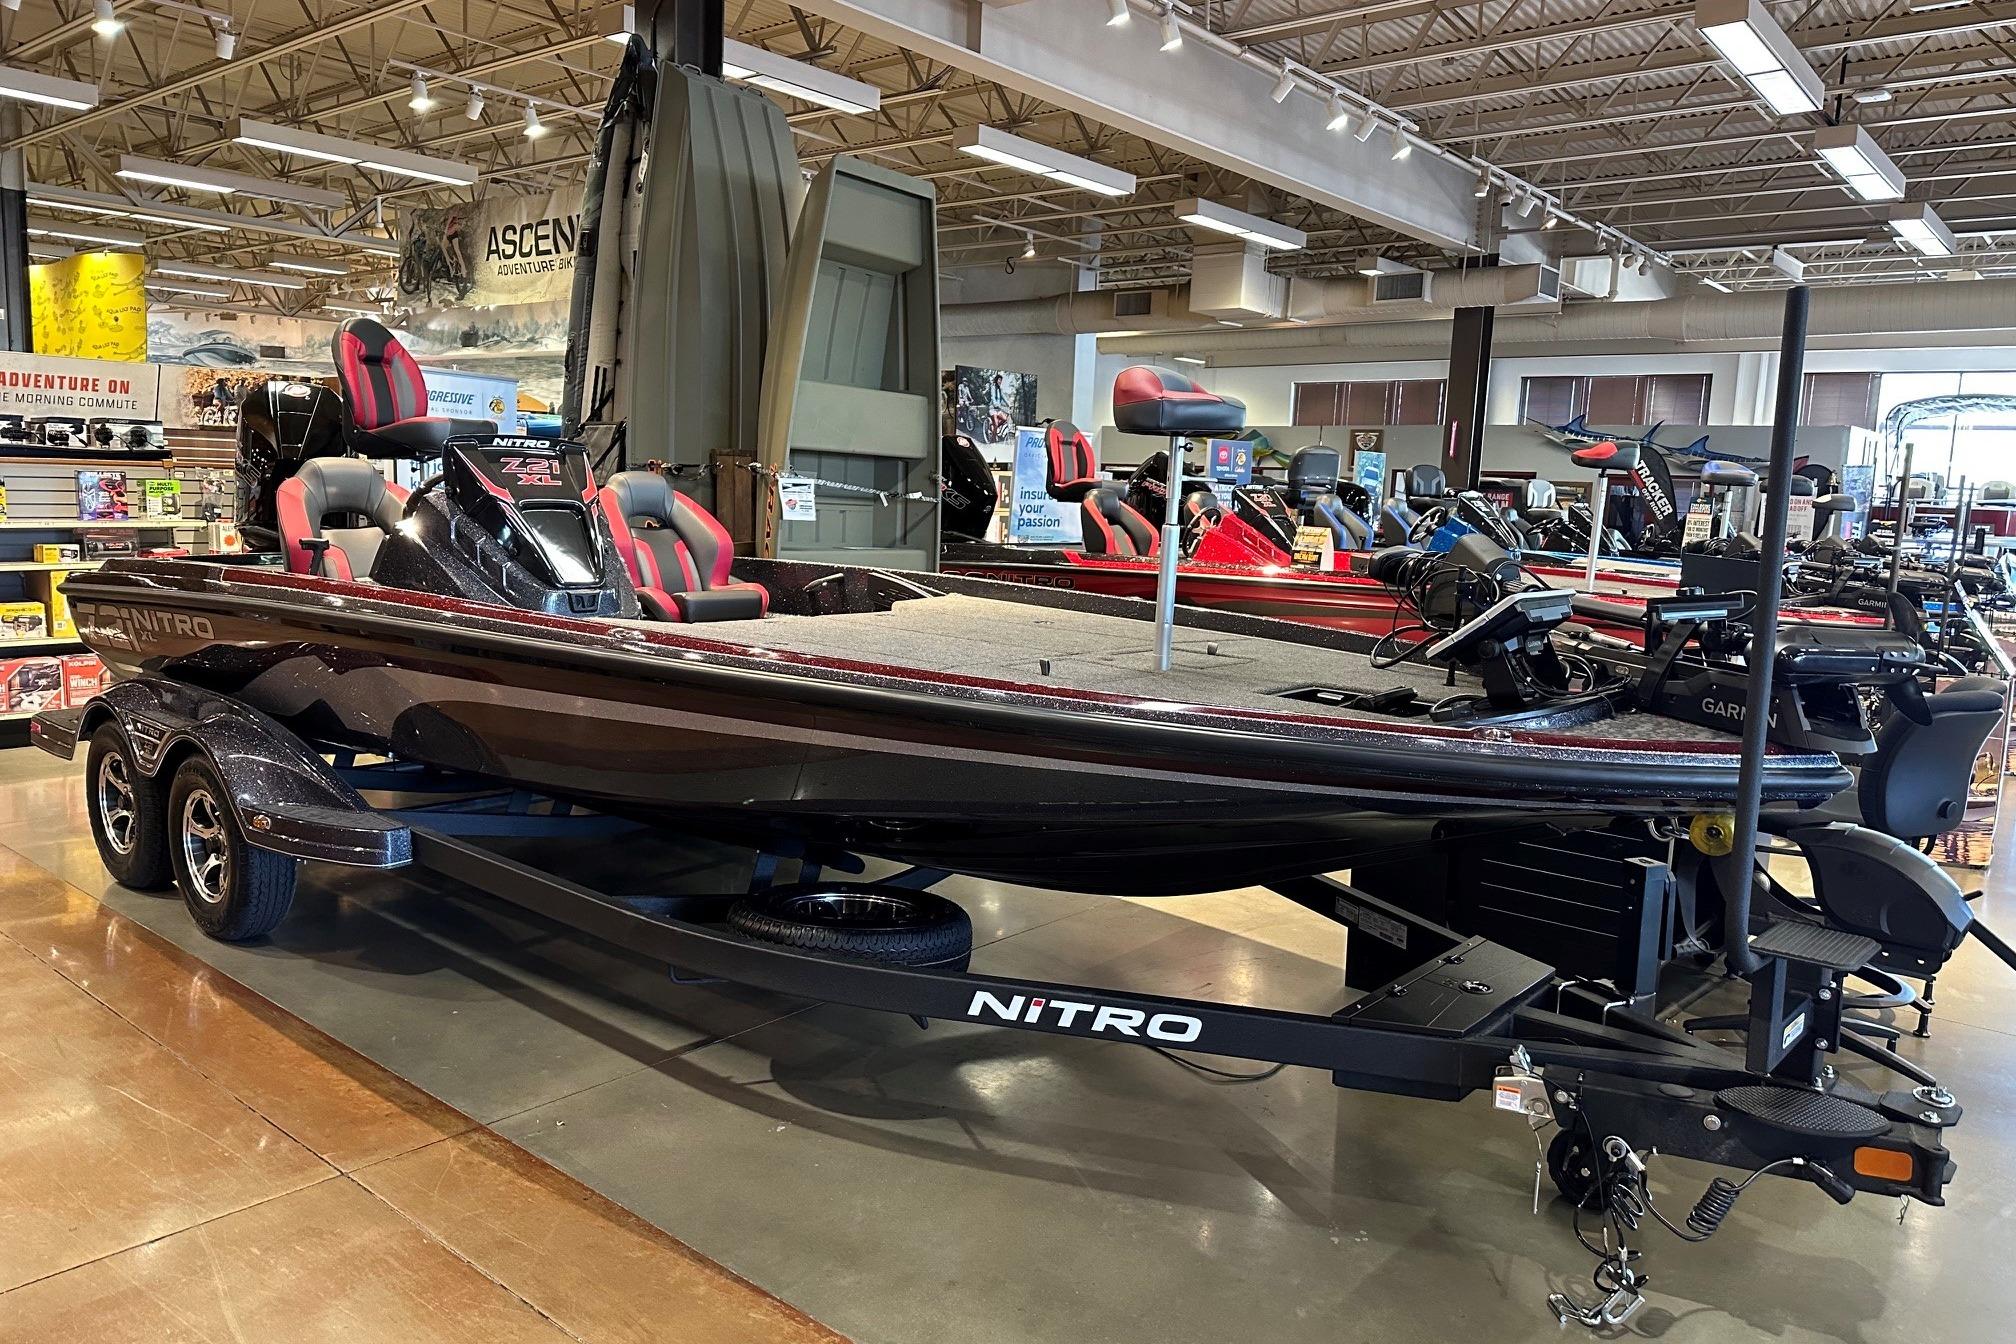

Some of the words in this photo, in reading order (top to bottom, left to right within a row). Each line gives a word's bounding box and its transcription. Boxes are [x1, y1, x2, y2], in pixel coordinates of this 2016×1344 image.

[486, 214, 580, 261] ASCEN
[498, 259, 555, 276] ADVENTURE
[0, 371, 99, 392] ADVENTURE
[108, 379, 130, 395] ON
[15, 393, 73, 406] MORNING
[79, 396, 138, 410] COMMUTE
[427, 389, 475, 405] GRESSIVE
[493, 437, 550, 449] NITRO
[500, 457, 560, 474] Z21
[517, 473, 562, 486] XL
[1636, 459, 1673, 516] TRACKER
[1019, 503, 1045, 516] your
[1641, 488, 1652, 501] OFF
[1649, 501, 1664, 520] ROAD
[1017, 514, 1060, 531] passion
[130, 607, 216, 640] NITRO
[69, 677, 98, 687] WINCH
[1701, 697, 1778, 729] GARN
[966, 990, 1203, 1043] NITRO
